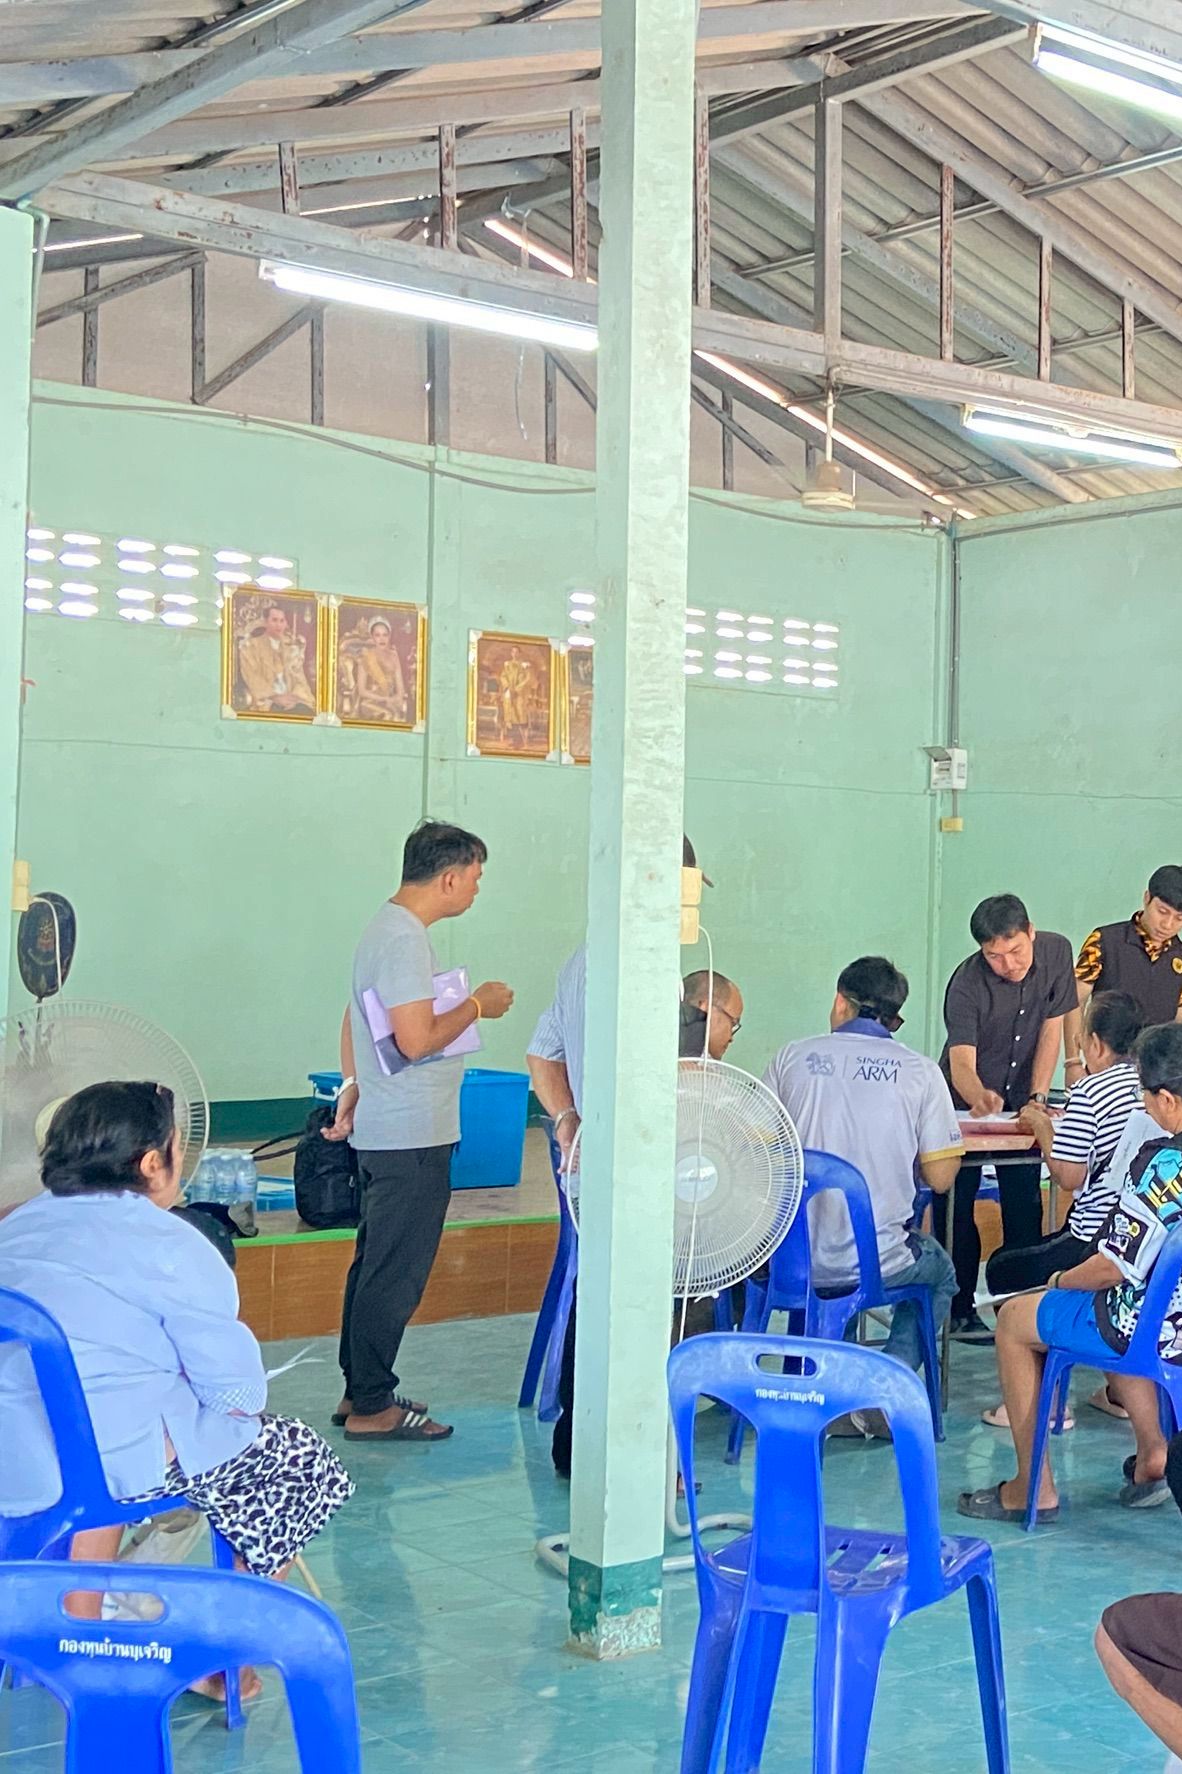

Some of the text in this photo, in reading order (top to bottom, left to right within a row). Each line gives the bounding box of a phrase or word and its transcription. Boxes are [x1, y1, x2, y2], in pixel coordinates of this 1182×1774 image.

[856, 1056, 902, 1068] SINGHA
[852, 1066, 898, 1084] ARM
[59, 1637, 172, 1664] กองทุนบ้านบุเจริญ
